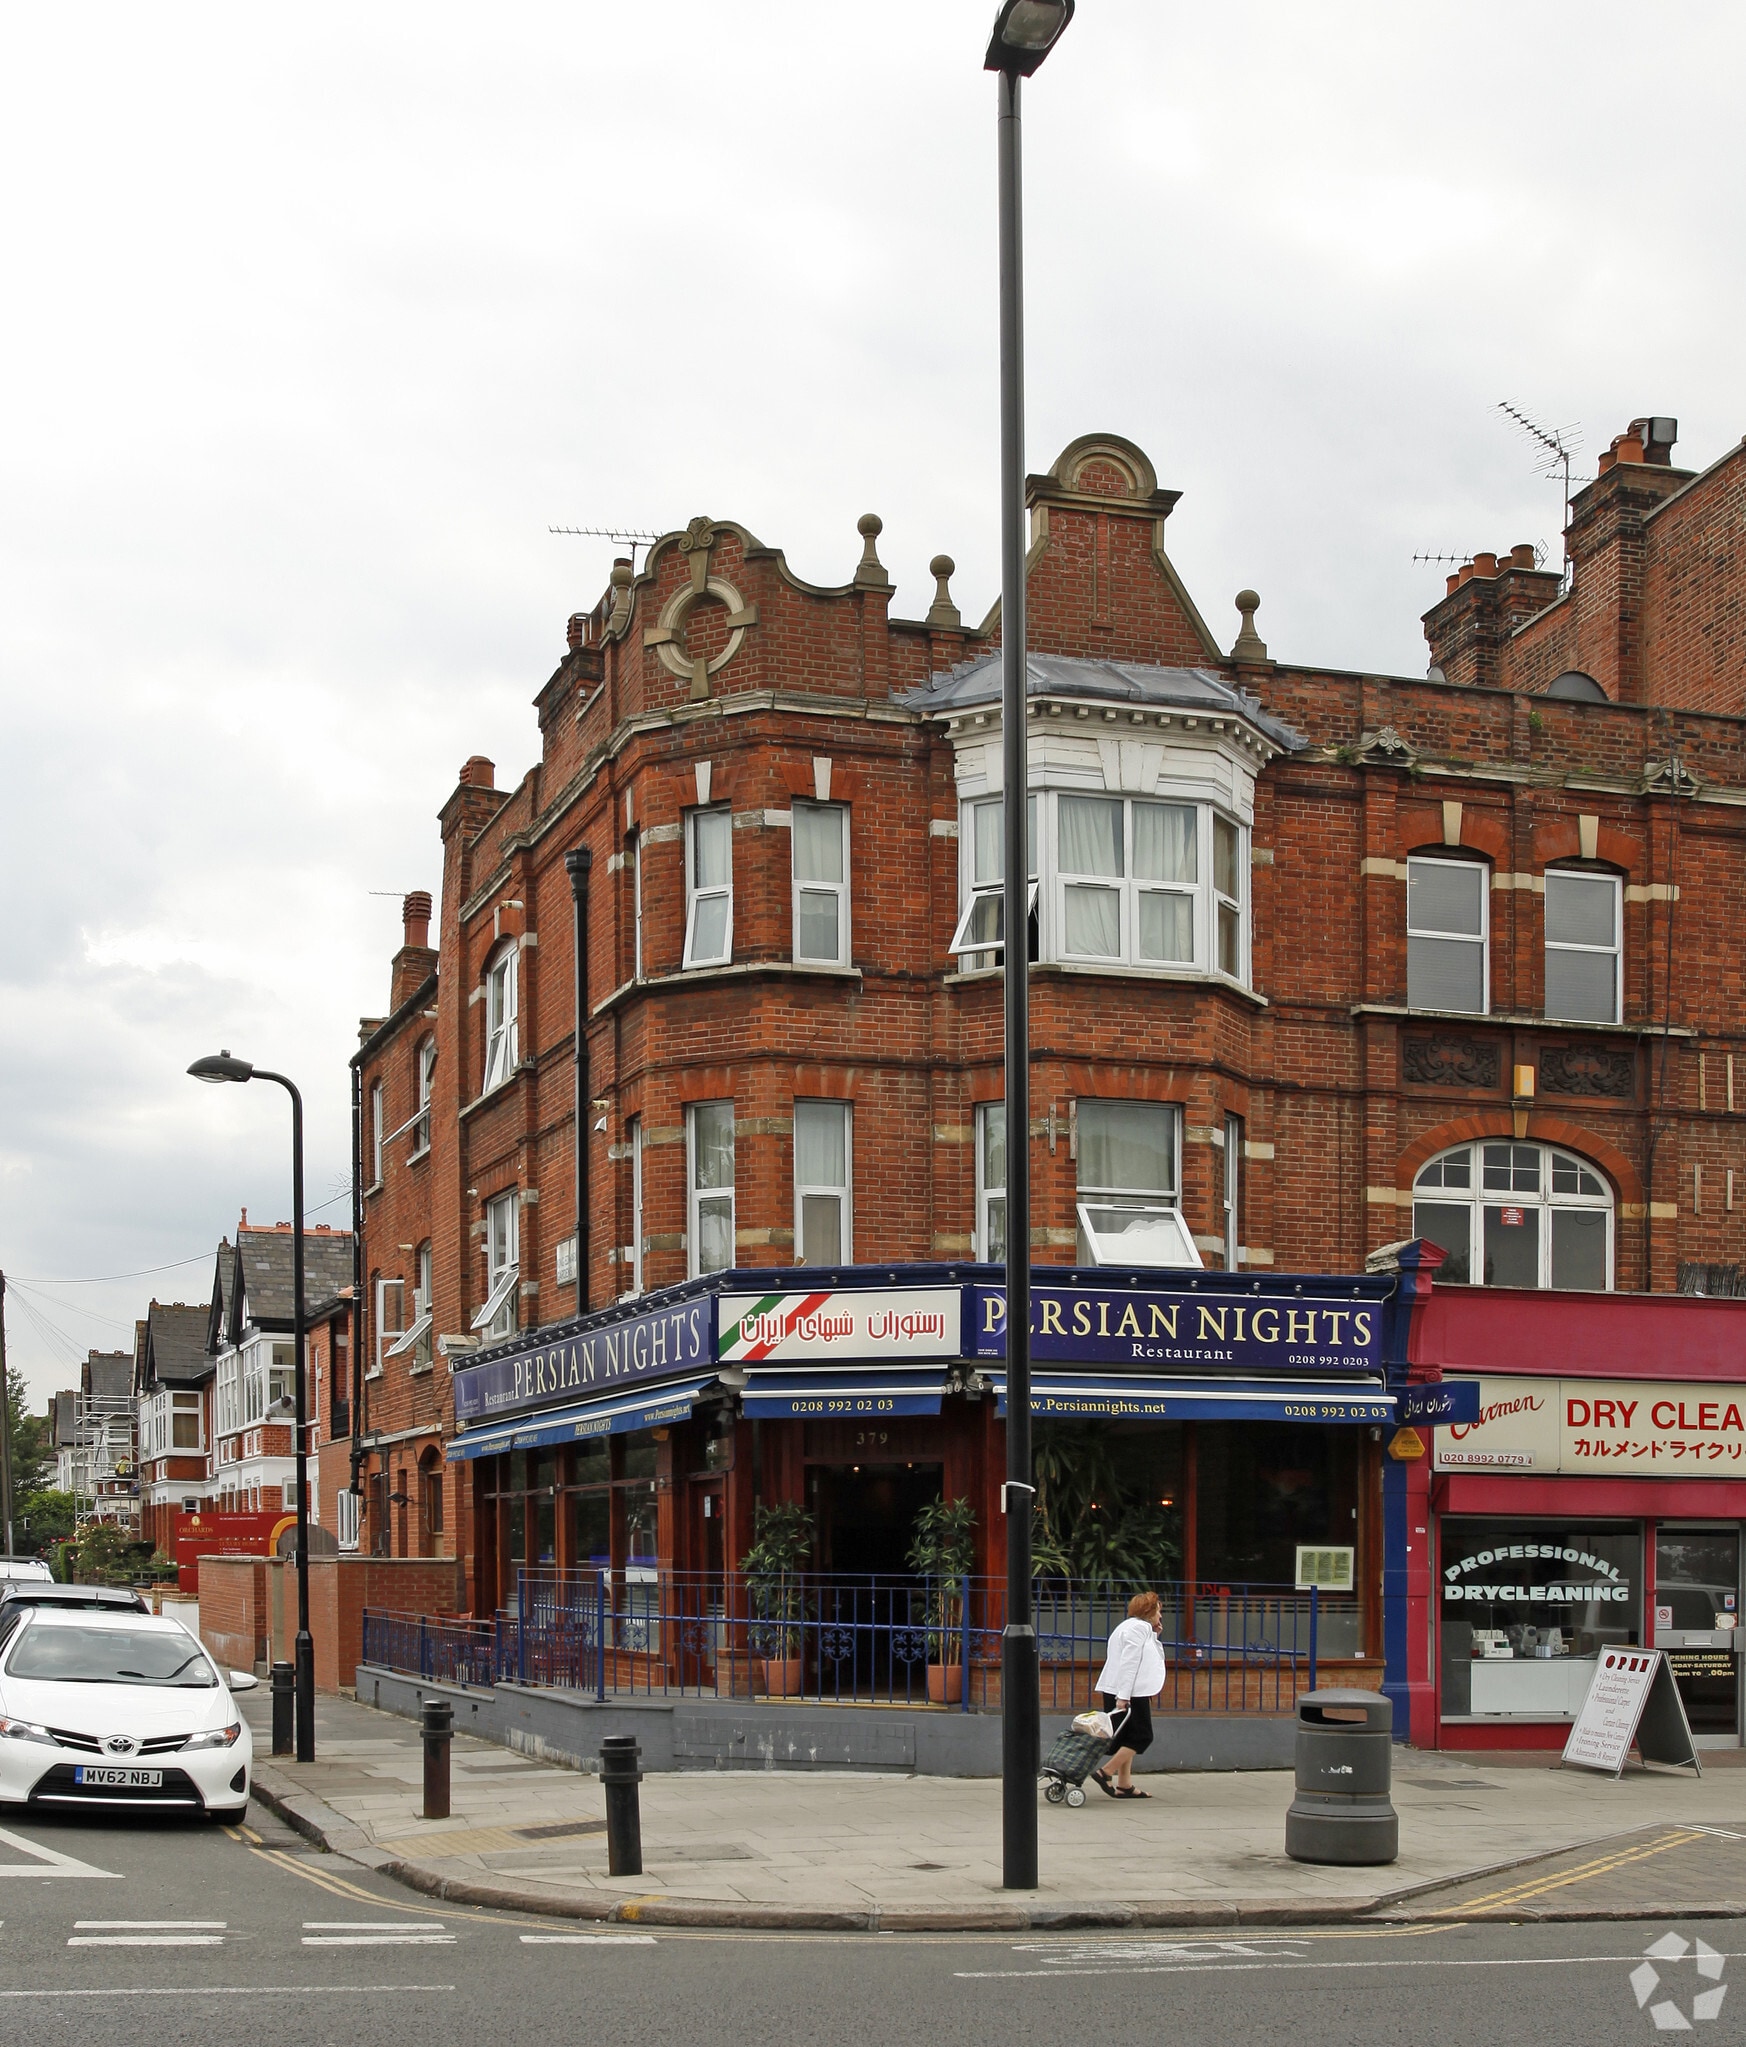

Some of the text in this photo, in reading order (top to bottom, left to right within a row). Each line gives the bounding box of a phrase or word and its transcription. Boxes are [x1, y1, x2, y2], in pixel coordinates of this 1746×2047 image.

[740, 1310, 945, 1345] رستوران شبهای ایران
[982, 1298, 1372, 1347] PRSIAN NIGHTS
[513, 1308, 701, 1399] PERSIAN NIGHTS
[1131, 1343, 1233, 1360] Restaurant
[1288, 1355, 1370, 1367] 0208 992 0203
[484, 1391, 515, 1407] Restaurant
[791, 1399, 894, 1411] 0208 992 02 03
[1005, 1398, 1166, 1415] w.Persiannights.net
[1427, 1394, 1453, 1414] رستوران
[1284, 1405, 1387, 1418] 0208 992 02 03
[1566, 1399, 1745, 1431] DRY CLEA
[856, 1432, 889, 1445] 379
[1574, 1438, 1746, 1460] カルメンドライクリ
[1443, 1453, 1524, 1464] 020 8992 0779
[179, 1526, 214, 1534] ORCHARDS
[1444, 1544, 1621, 1583] PROFESSIONAL
[1444, 1586, 1630, 1602] DRYCLEANING
[1578, 1736, 1621, 1751] Ironing Service
[86, 1770, 160, 1785] MV62 NBJ
